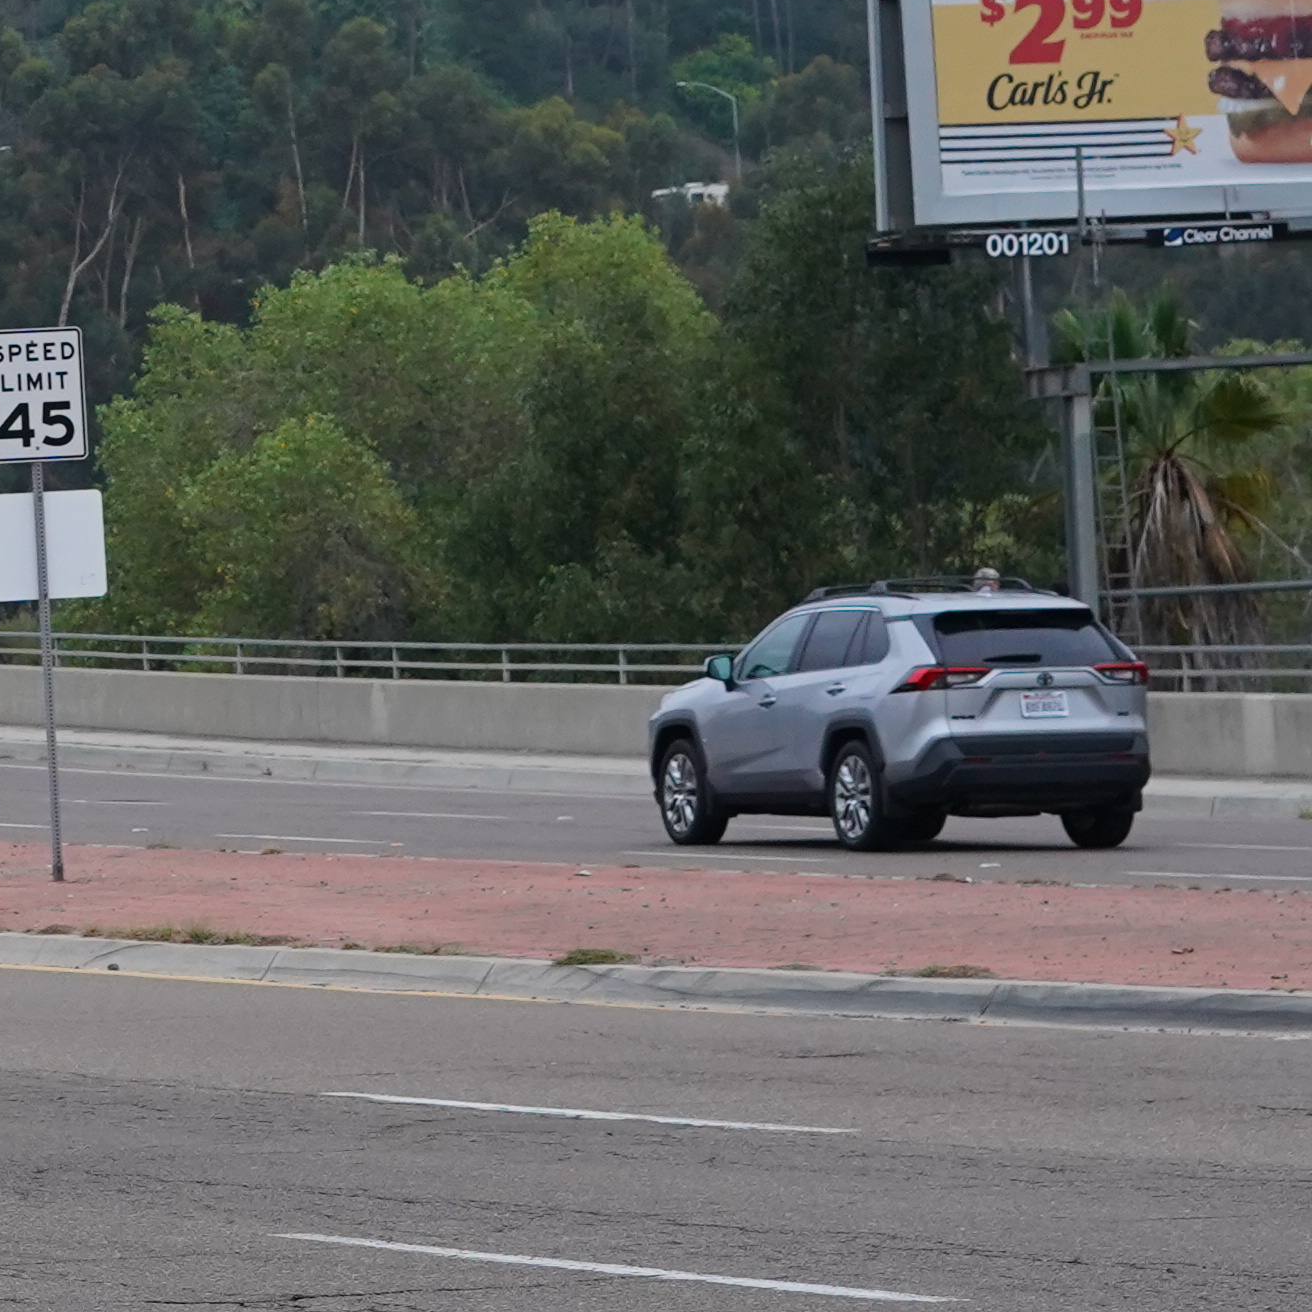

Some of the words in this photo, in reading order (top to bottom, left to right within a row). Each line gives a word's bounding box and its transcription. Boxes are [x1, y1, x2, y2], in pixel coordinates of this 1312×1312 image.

[986, 70, 1069, 111] Carl's
[1073, 71, 1114, 109] Jr.
[985, 233, 1069, 257] 001201
[1183, 228, 1217, 244] Clear
[1219, 225, 1273, 242] Channel
[1, 371, 68, 392] LIMIT
